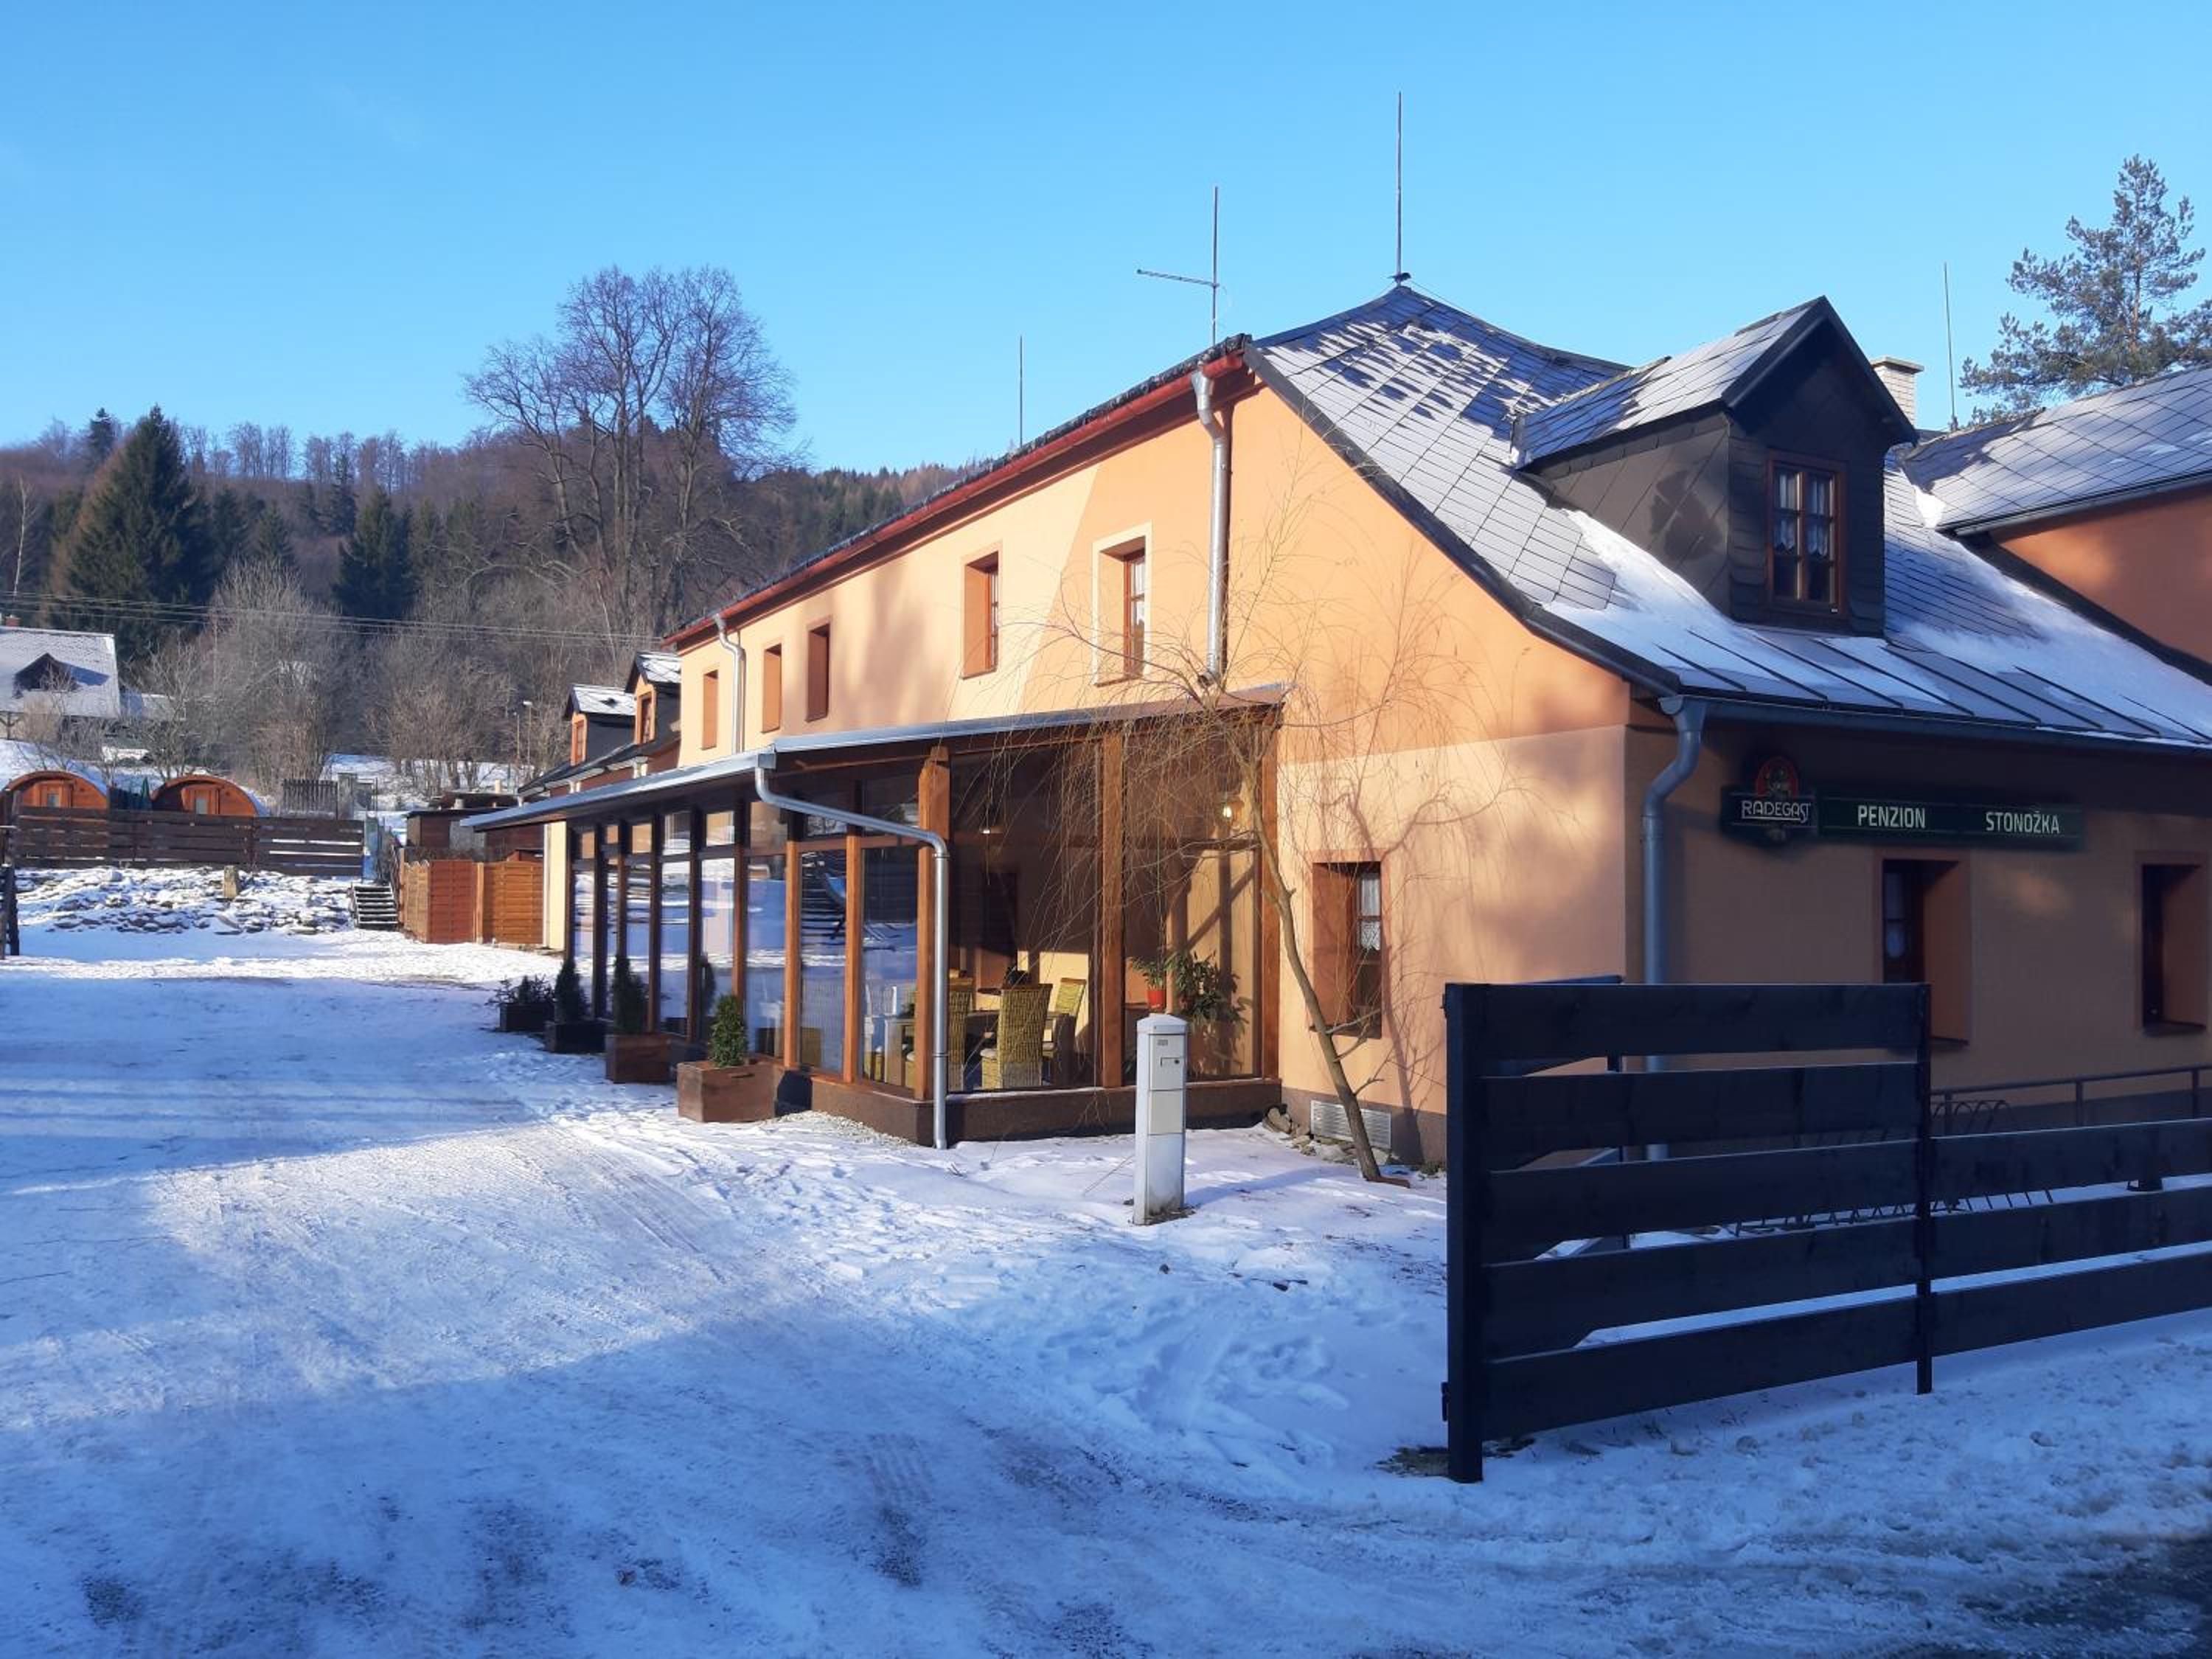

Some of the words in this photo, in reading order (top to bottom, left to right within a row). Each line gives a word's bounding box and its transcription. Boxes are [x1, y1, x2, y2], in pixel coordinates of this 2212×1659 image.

[1742, 800, 1811, 822] RADEGAST
[1857, 804, 1926, 829] PENZION
[1986, 811, 2060, 834] STONOŽKA
